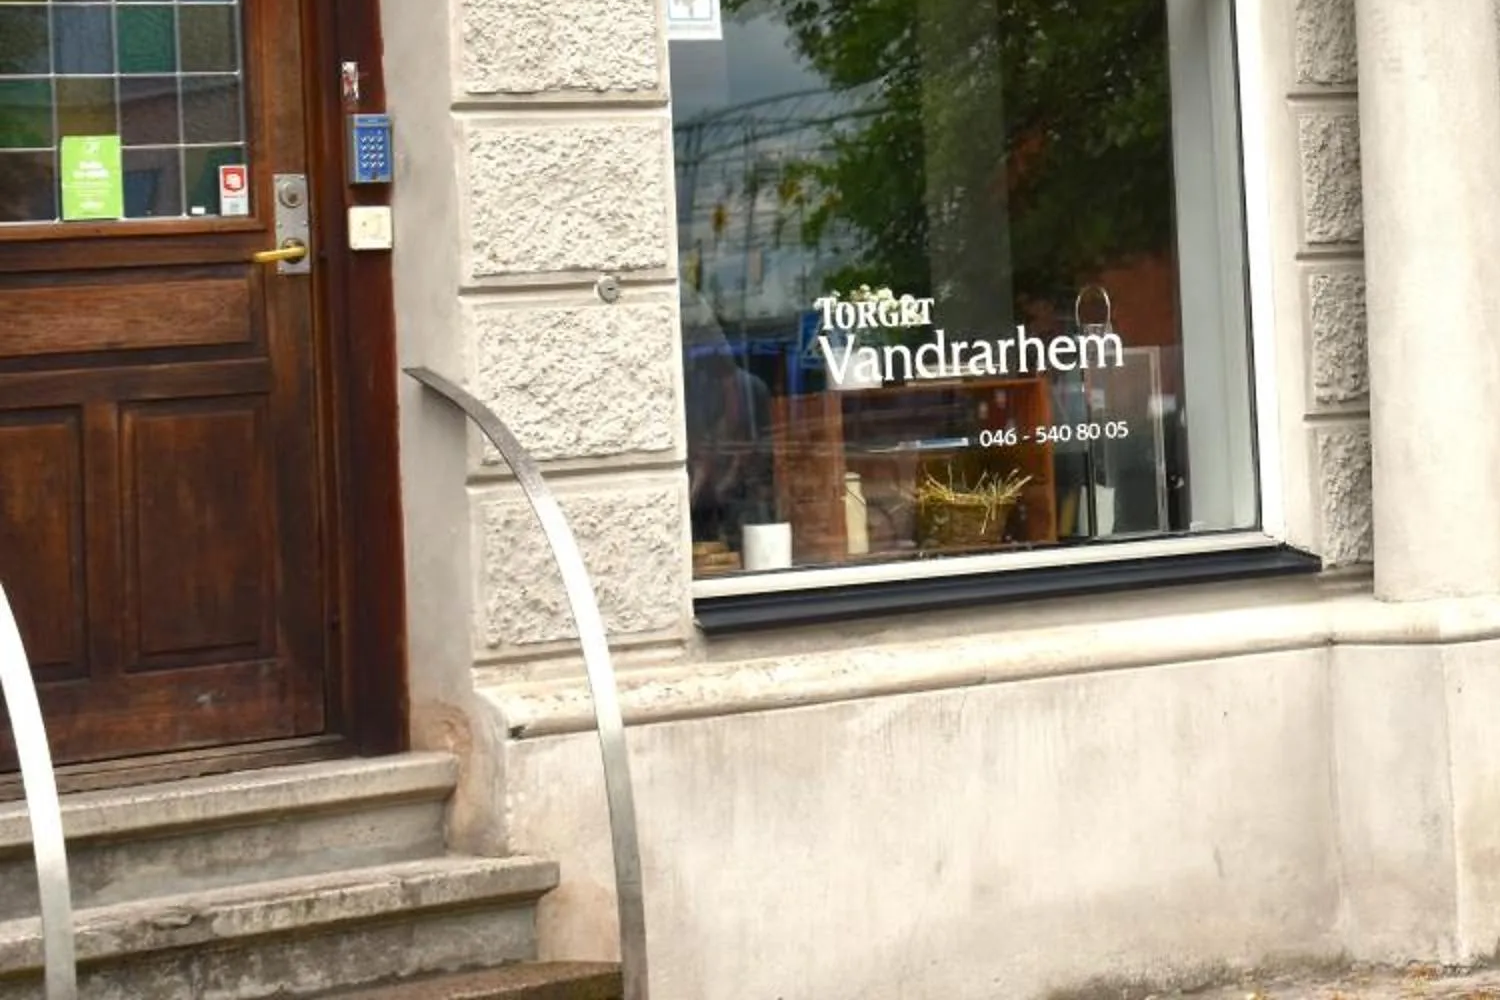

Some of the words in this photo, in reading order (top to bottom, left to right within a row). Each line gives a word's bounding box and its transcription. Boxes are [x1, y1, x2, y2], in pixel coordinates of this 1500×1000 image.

[817, 297, 934, 330] TORGET
[818, 324, 1124, 385] Vandrarhem
[979, 429, 1017, 447] 046
[1035, 426, 1071, 444] 540
[1076, 423, 1100, 440] 80
[1105, 421, 1128, 438] 05
